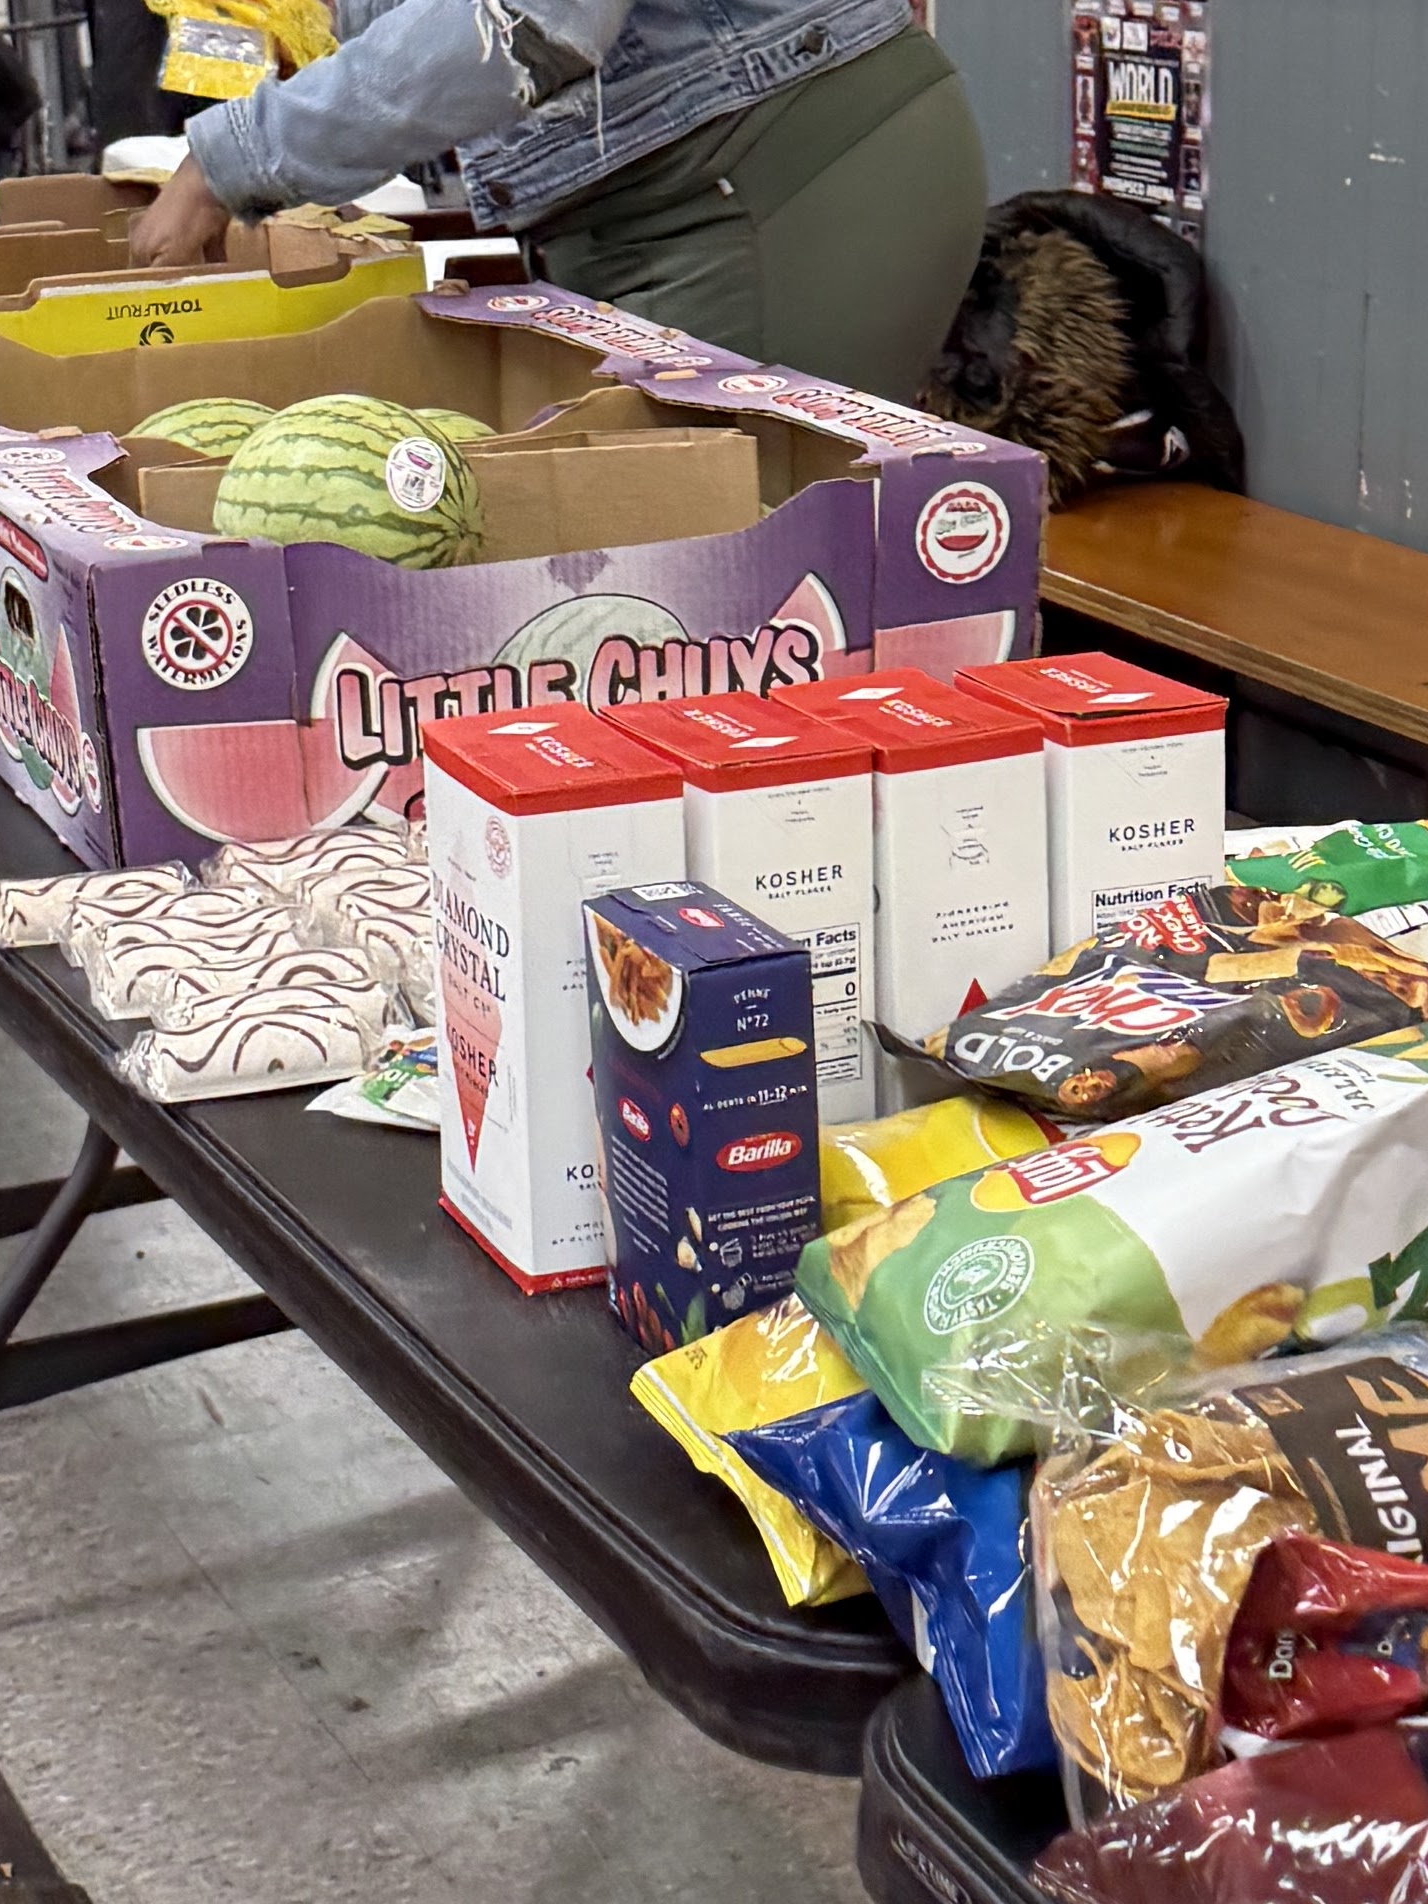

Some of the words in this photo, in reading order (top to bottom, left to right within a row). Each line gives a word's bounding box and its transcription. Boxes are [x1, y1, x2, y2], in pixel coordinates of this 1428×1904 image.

[1108, 62, 1174, 104] WORLD
[148, 580, 236, 622] SEEDLESS
[147, 618, 247, 686] WATERMELONS
[336, 658, 585, 769] LITTLE
[587, 618, 824, 719] CHUYS
[1109, 818, 1196, 843] KOSHER
[755, 864, 844, 892] KOSHER
[1095, 888, 1164, 907] Nutrition
[816, 927, 857, 947] Facts
[437, 917, 507, 1002] CRYSTAL
[845, 982, 856, 996] 0
[982, 984, 1205, 1035] Chex
[954, 1031, 1073, 1082] BOLD
[757, 1085, 787, 1104] 11-12
[728, 1139, 793, 1166] Barilla
